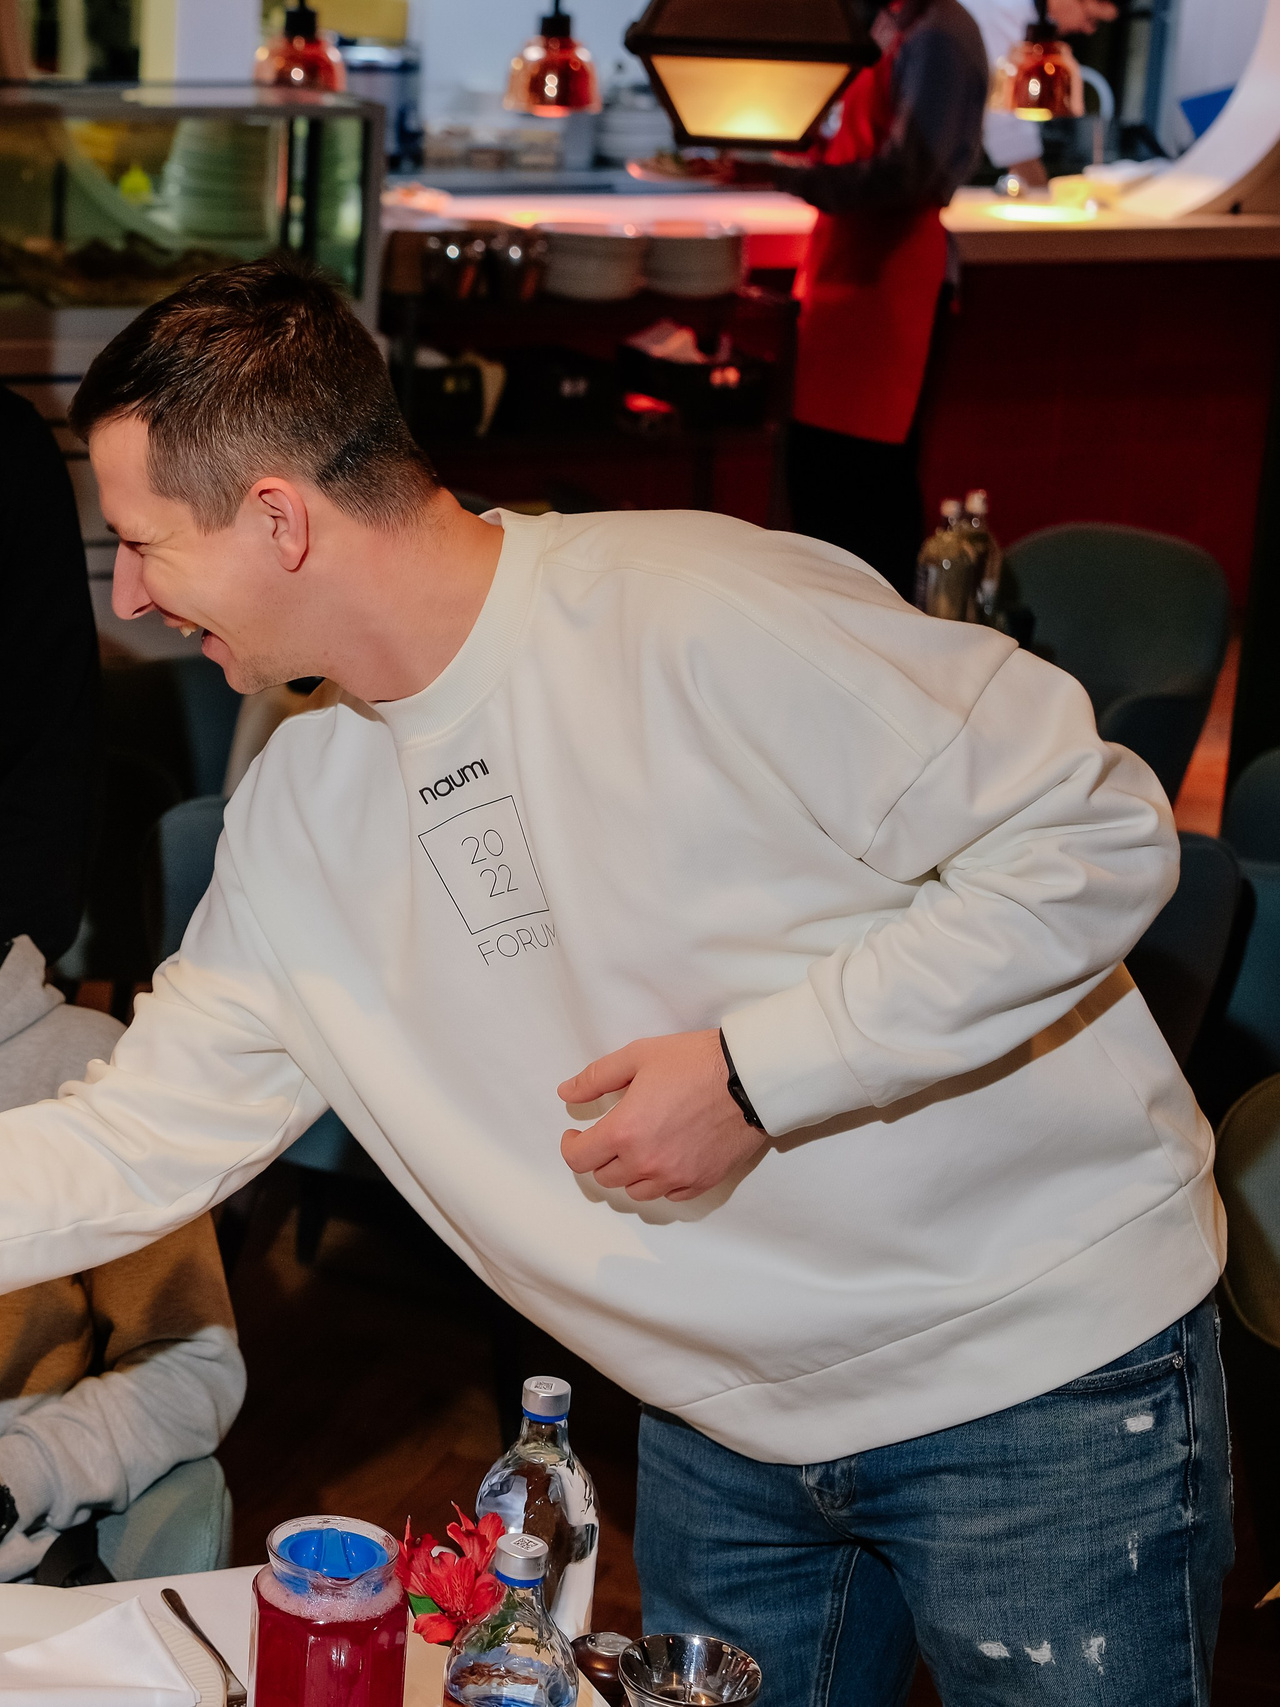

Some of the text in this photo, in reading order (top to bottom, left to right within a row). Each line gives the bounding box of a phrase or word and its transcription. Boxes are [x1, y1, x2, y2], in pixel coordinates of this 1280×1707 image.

[418, 758, 490, 805] naumi
[461, 829, 504, 865] 20
[479, 864, 519, 898] 22
